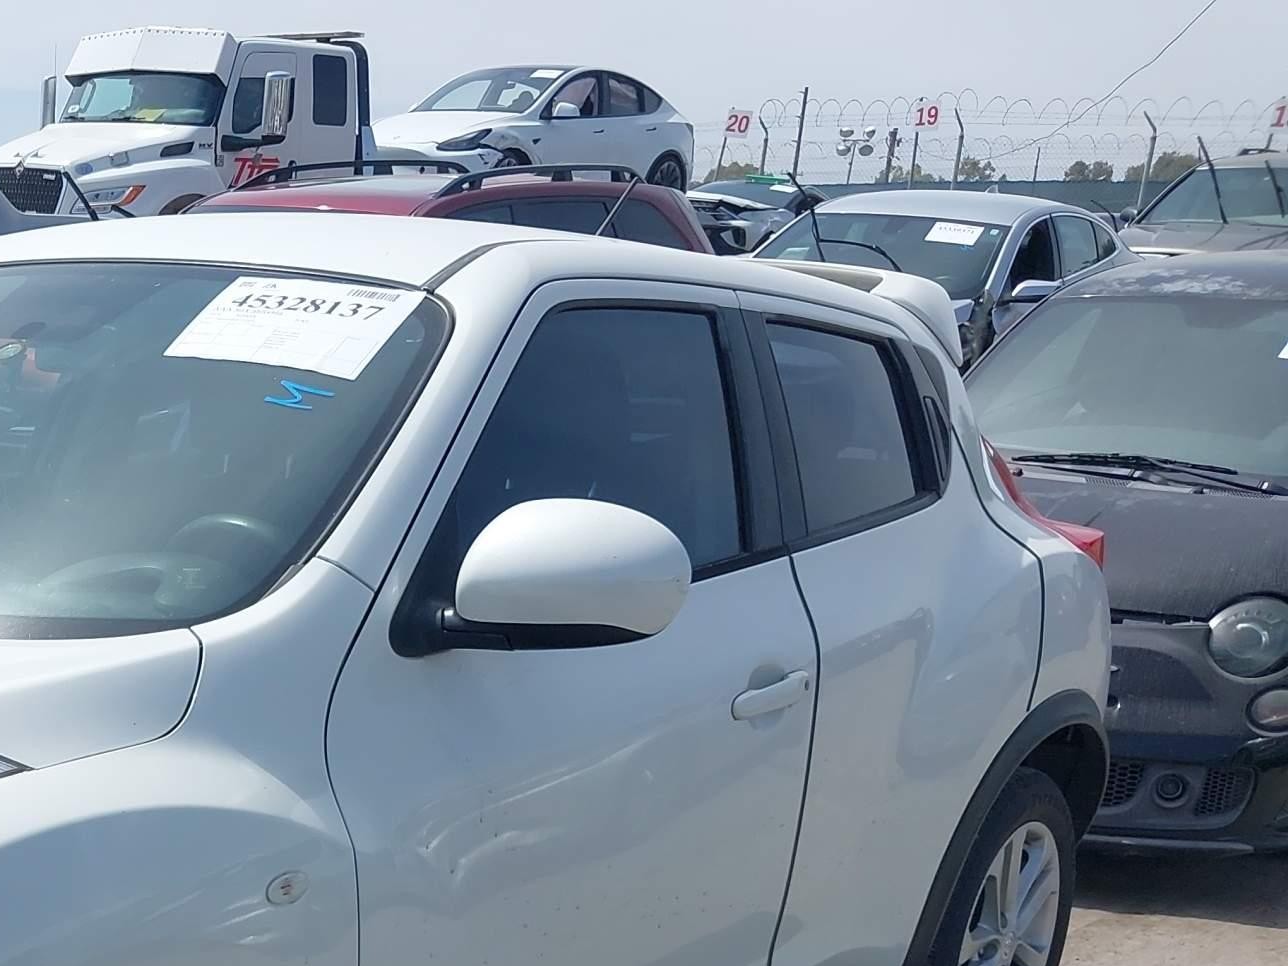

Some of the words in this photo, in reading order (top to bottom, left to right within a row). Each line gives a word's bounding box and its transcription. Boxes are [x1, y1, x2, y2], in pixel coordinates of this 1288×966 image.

[725, 113, 750, 134] 20
[915, 105, 939, 127] 19
[1270, 104, 1288, 128] 1
[231, 293, 386, 321] 45328137
